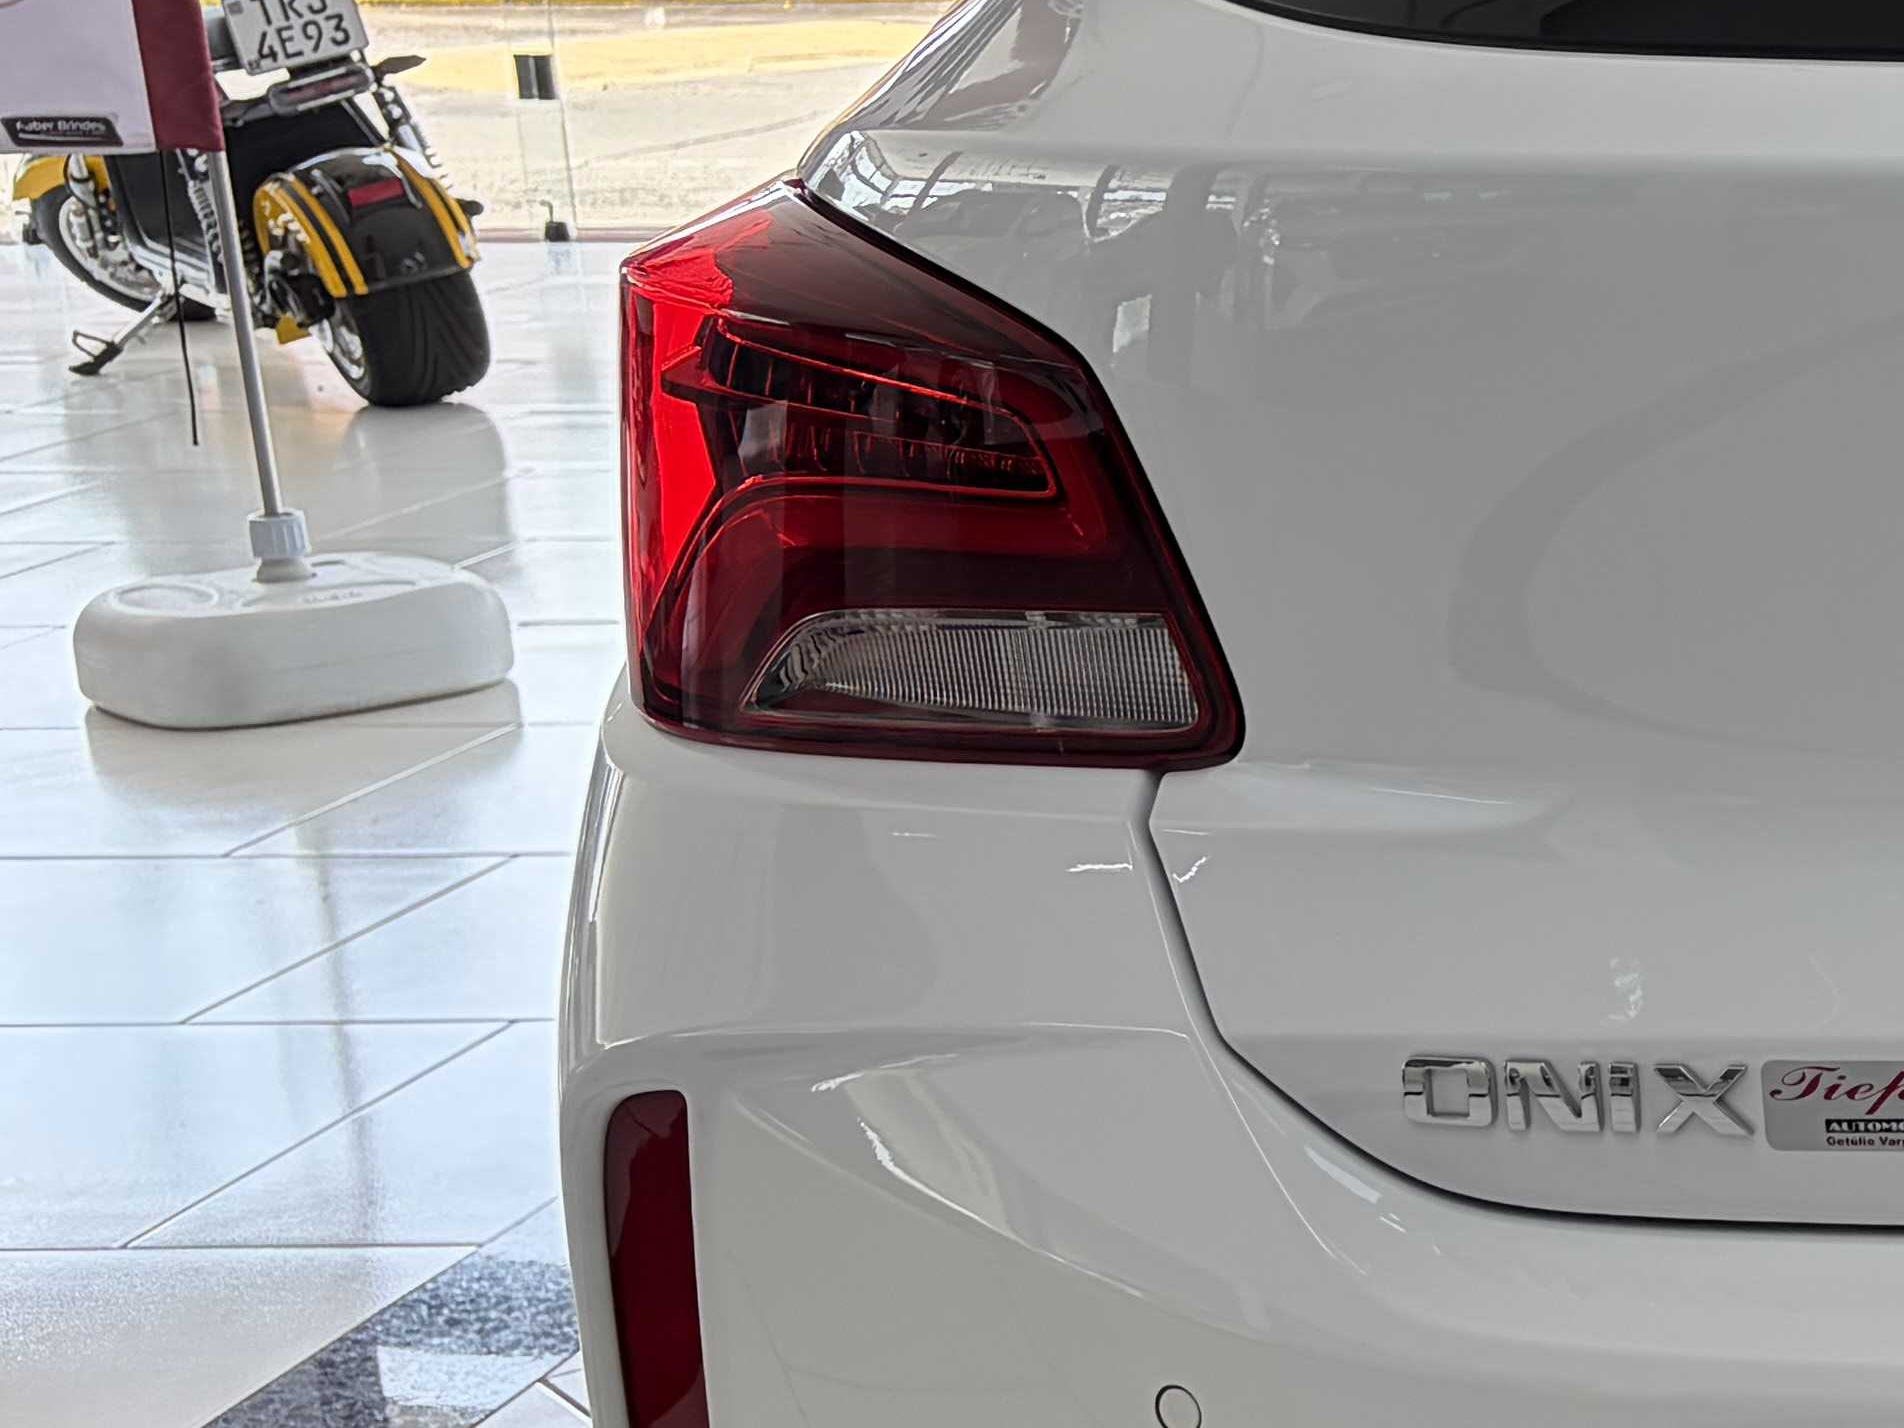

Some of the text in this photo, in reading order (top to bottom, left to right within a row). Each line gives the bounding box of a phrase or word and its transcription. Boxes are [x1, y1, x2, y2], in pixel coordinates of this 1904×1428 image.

[258, 14, 351, 63] 4E93
[1401, 1055, 1756, 1136] ONIX
[1826, 1136, 1875, 1147] Getúlio
